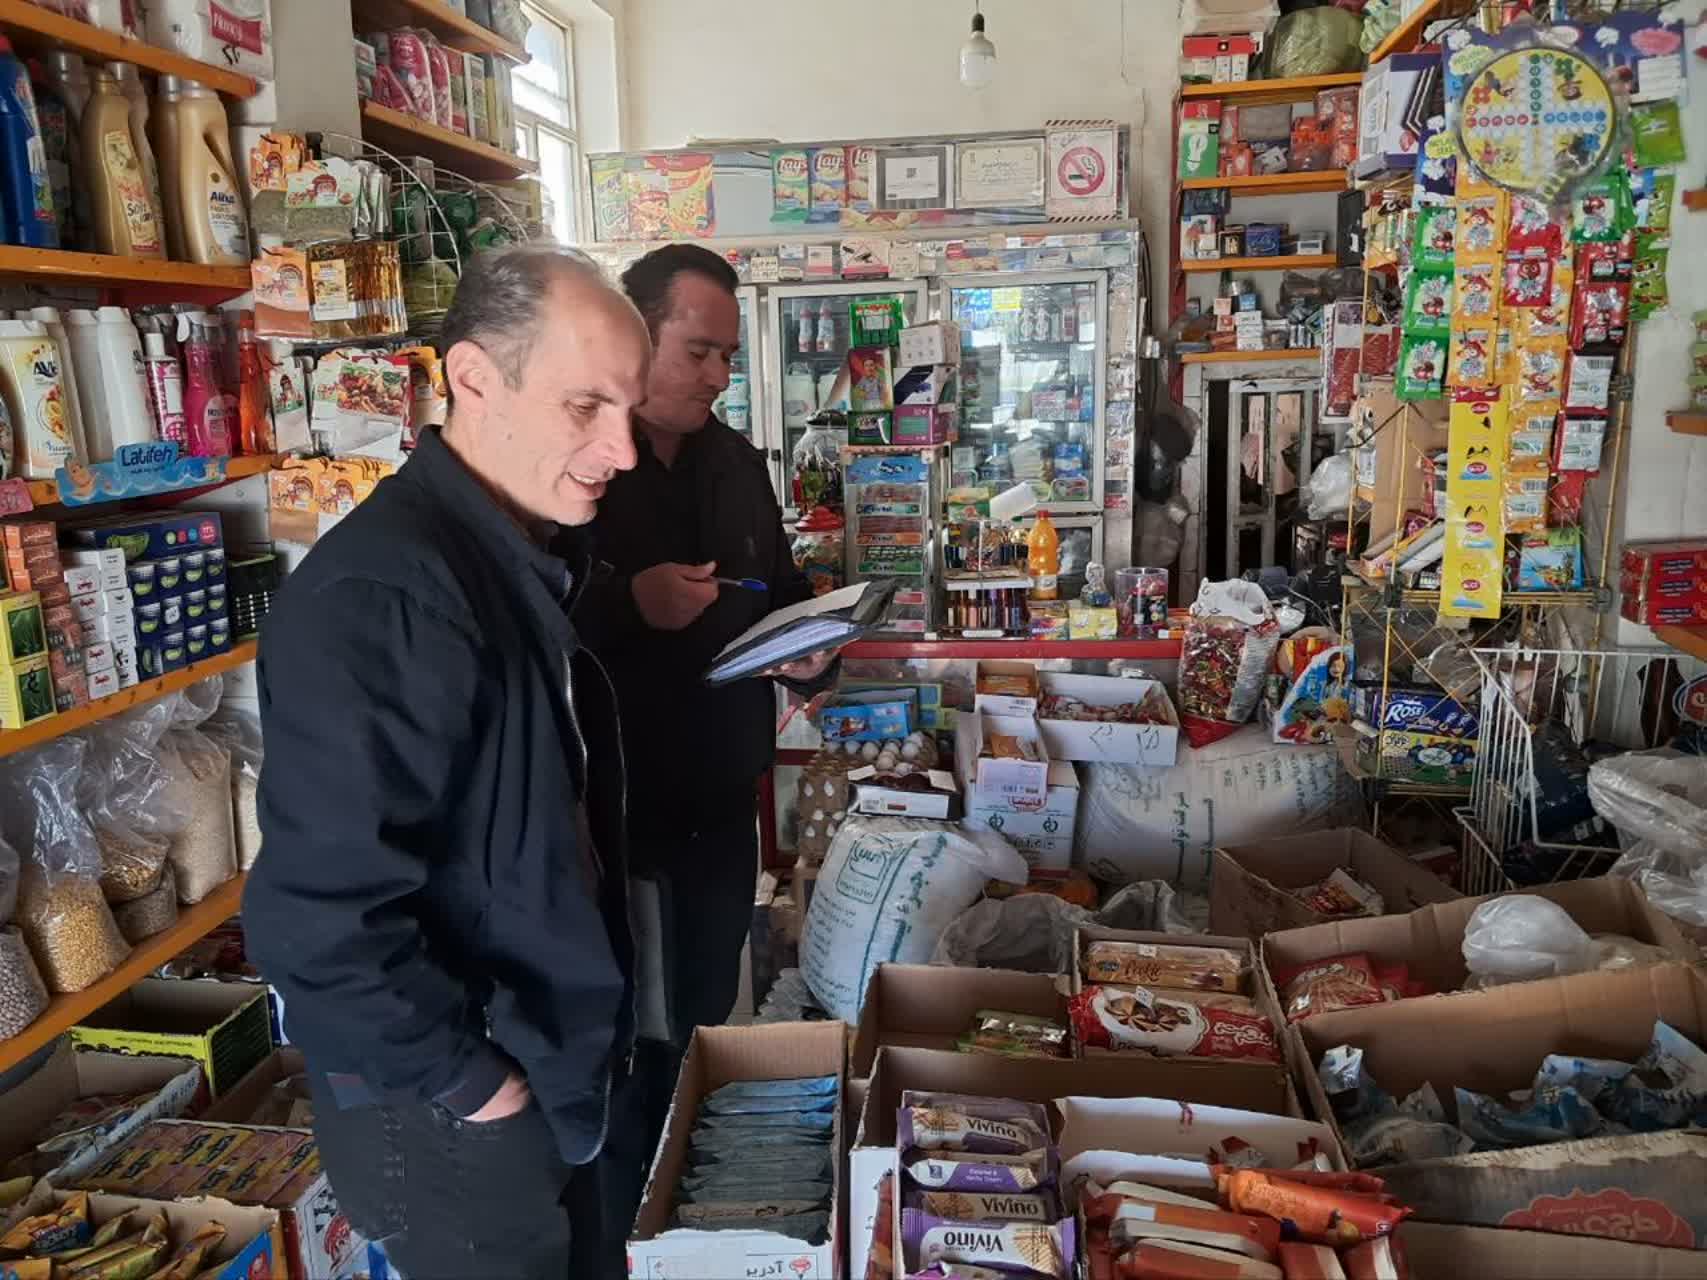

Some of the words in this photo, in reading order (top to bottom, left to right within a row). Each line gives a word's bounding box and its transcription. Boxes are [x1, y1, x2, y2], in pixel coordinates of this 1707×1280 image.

[966, 1118, 1017, 1138] Vivino
[981, 1197, 1039, 1216] Vivino
[943, 1231, 1003, 1252] Vivino
